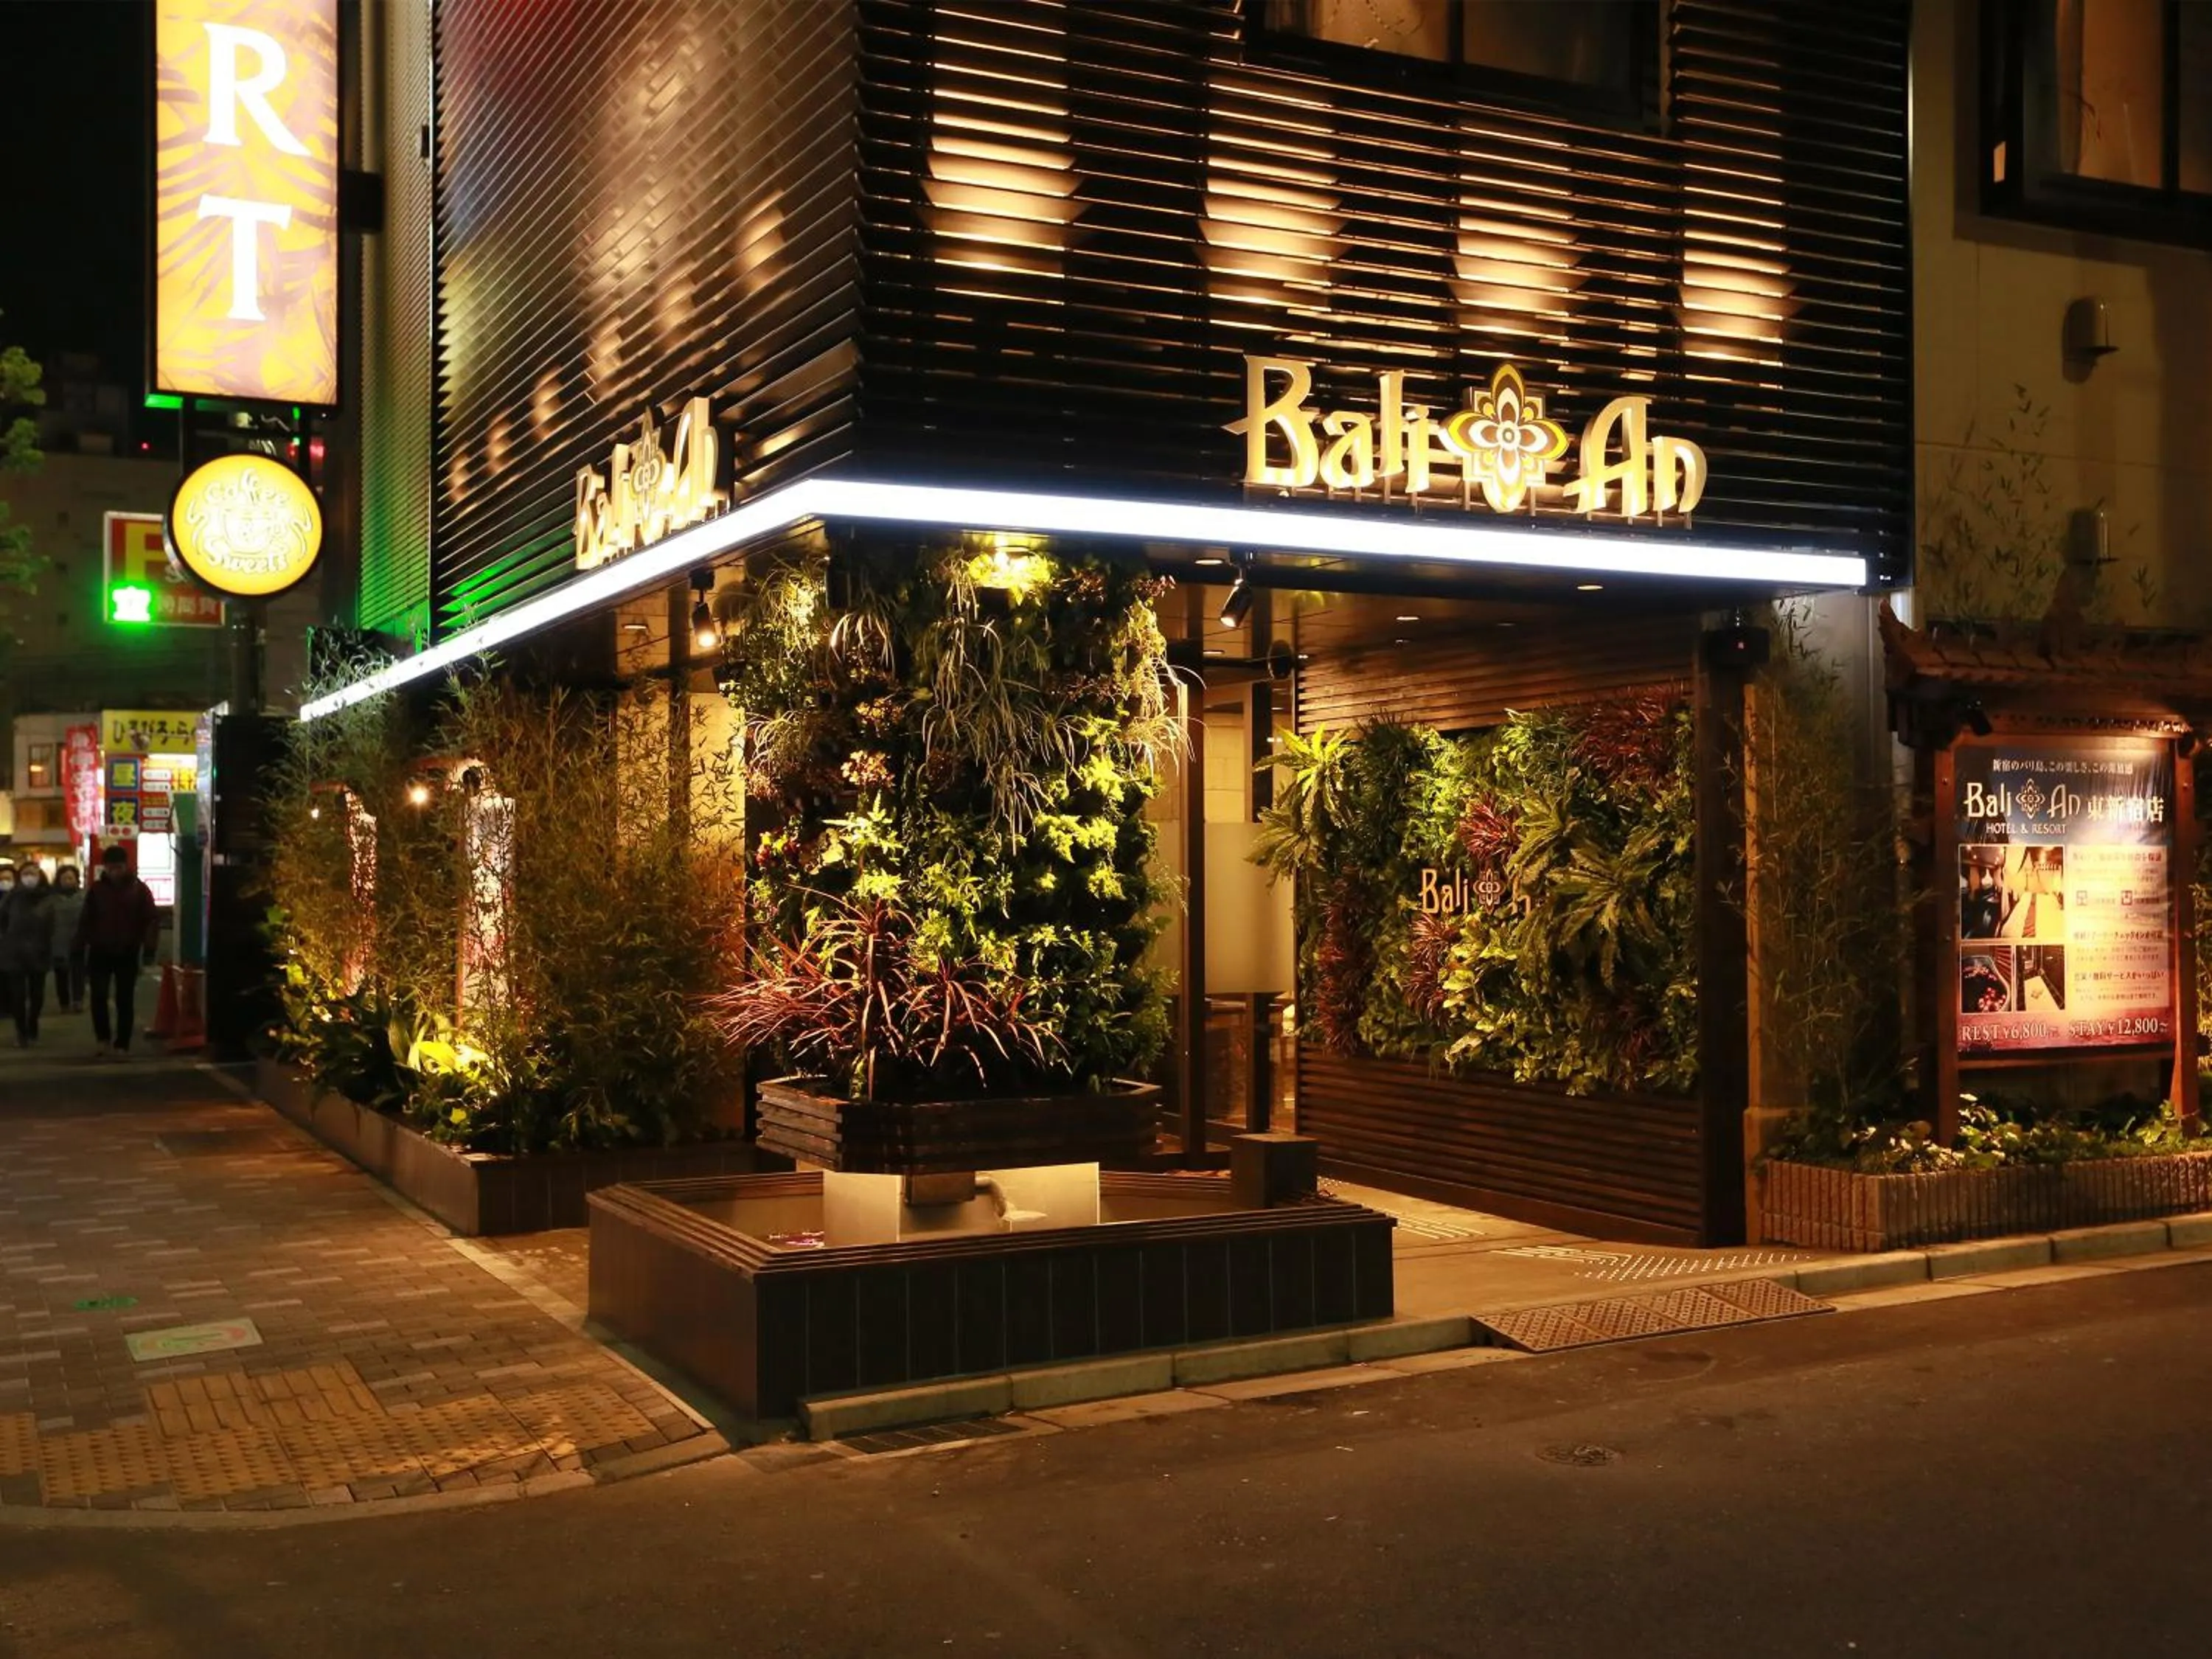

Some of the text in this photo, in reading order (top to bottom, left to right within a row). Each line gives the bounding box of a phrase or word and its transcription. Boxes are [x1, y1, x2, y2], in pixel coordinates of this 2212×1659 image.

[1222, 355, 1708, 518] Bali An
[204, 467, 291, 507] Coffee
[204, 536, 289, 574] Sweets
[1963, 782, 2164, 823] Bali An 東新宿店
[1986, 823, 2067, 834] HOTEL & RESORT
[1419, 866, 1468, 919] Bali
[1961, 1025, 2000, 1041] REST
[2068, 1020, 2104, 1038] STAY
